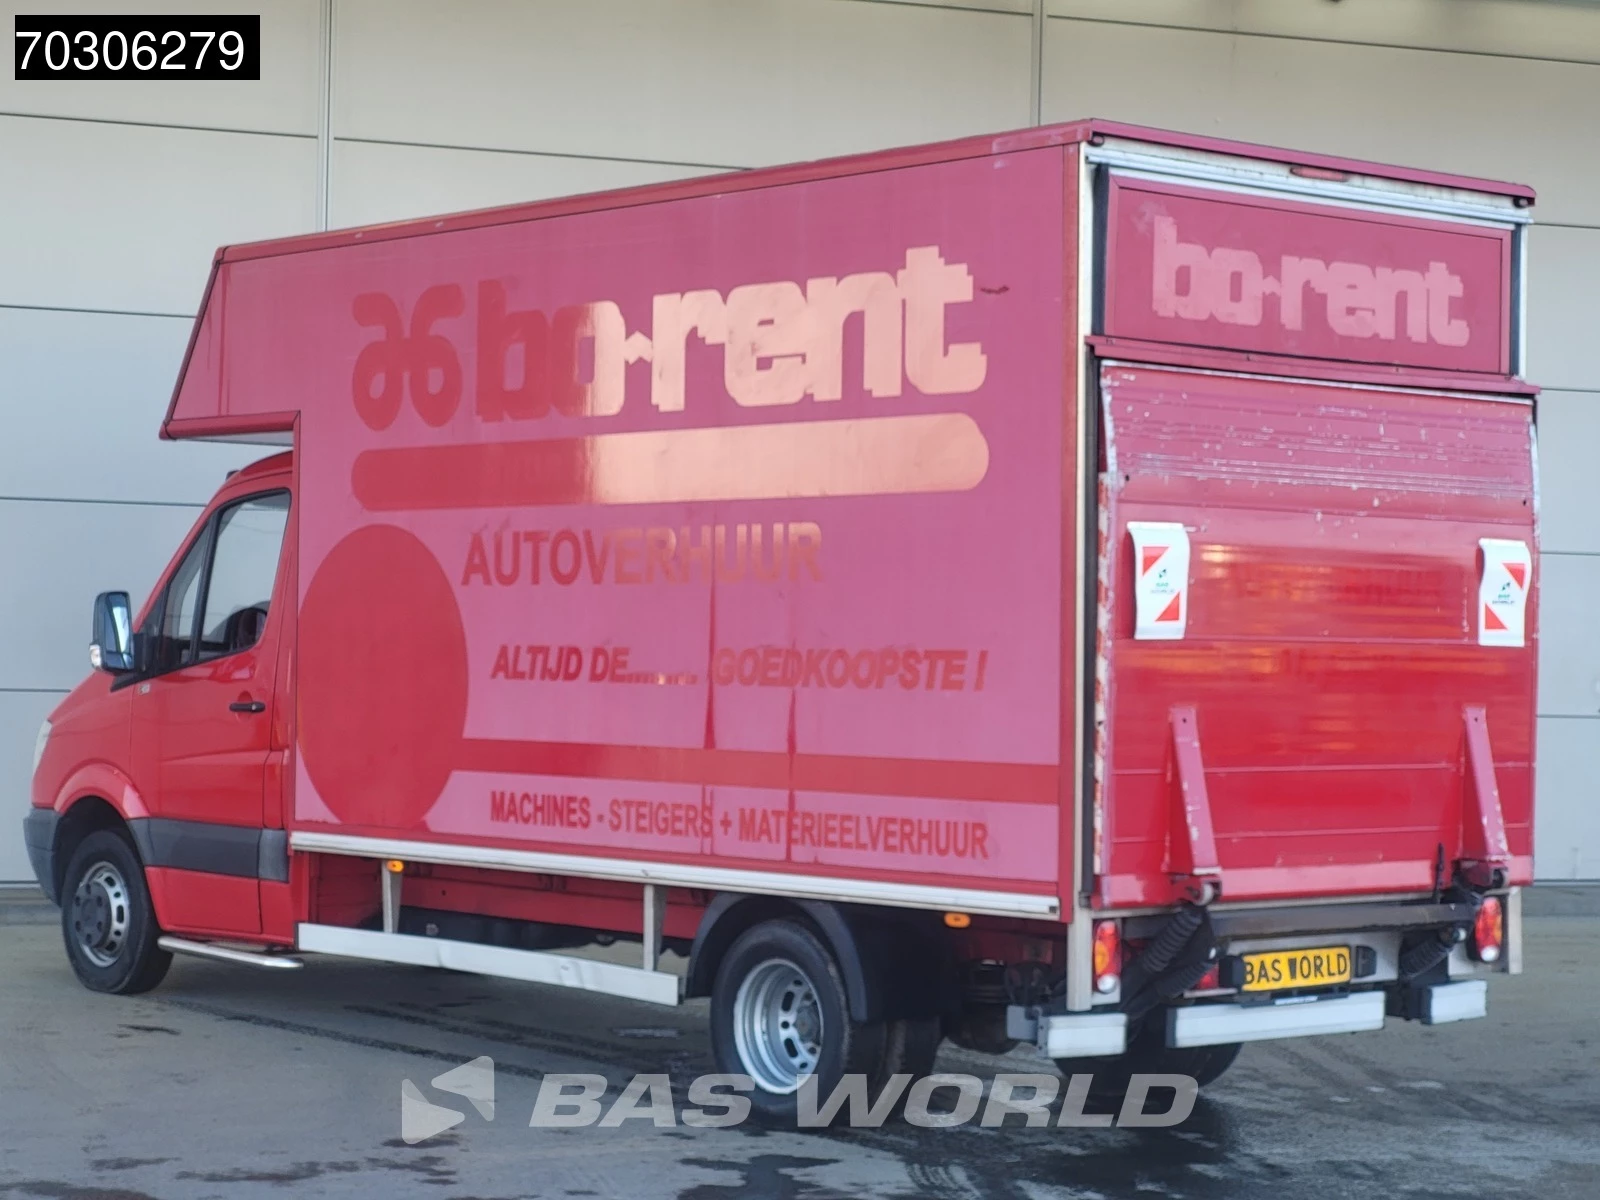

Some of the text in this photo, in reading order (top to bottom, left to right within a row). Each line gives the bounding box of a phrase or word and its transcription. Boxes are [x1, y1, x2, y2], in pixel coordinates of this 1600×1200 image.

[461, 520, 824, 587] AUTOVERHUUR
[490, 644, 583, 682] ALTIJD
[712, 647, 968, 692] GOEDKOOPSTE
[490, 790, 591, 830] MACHINES
[608, 798, 713, 838] STEIGERS
[720, 811, 733, 836] +
[738, 807, 989, 861] MATERIEELVERHUUR
[1245, 953, 1348, 985] BAS WORLD
